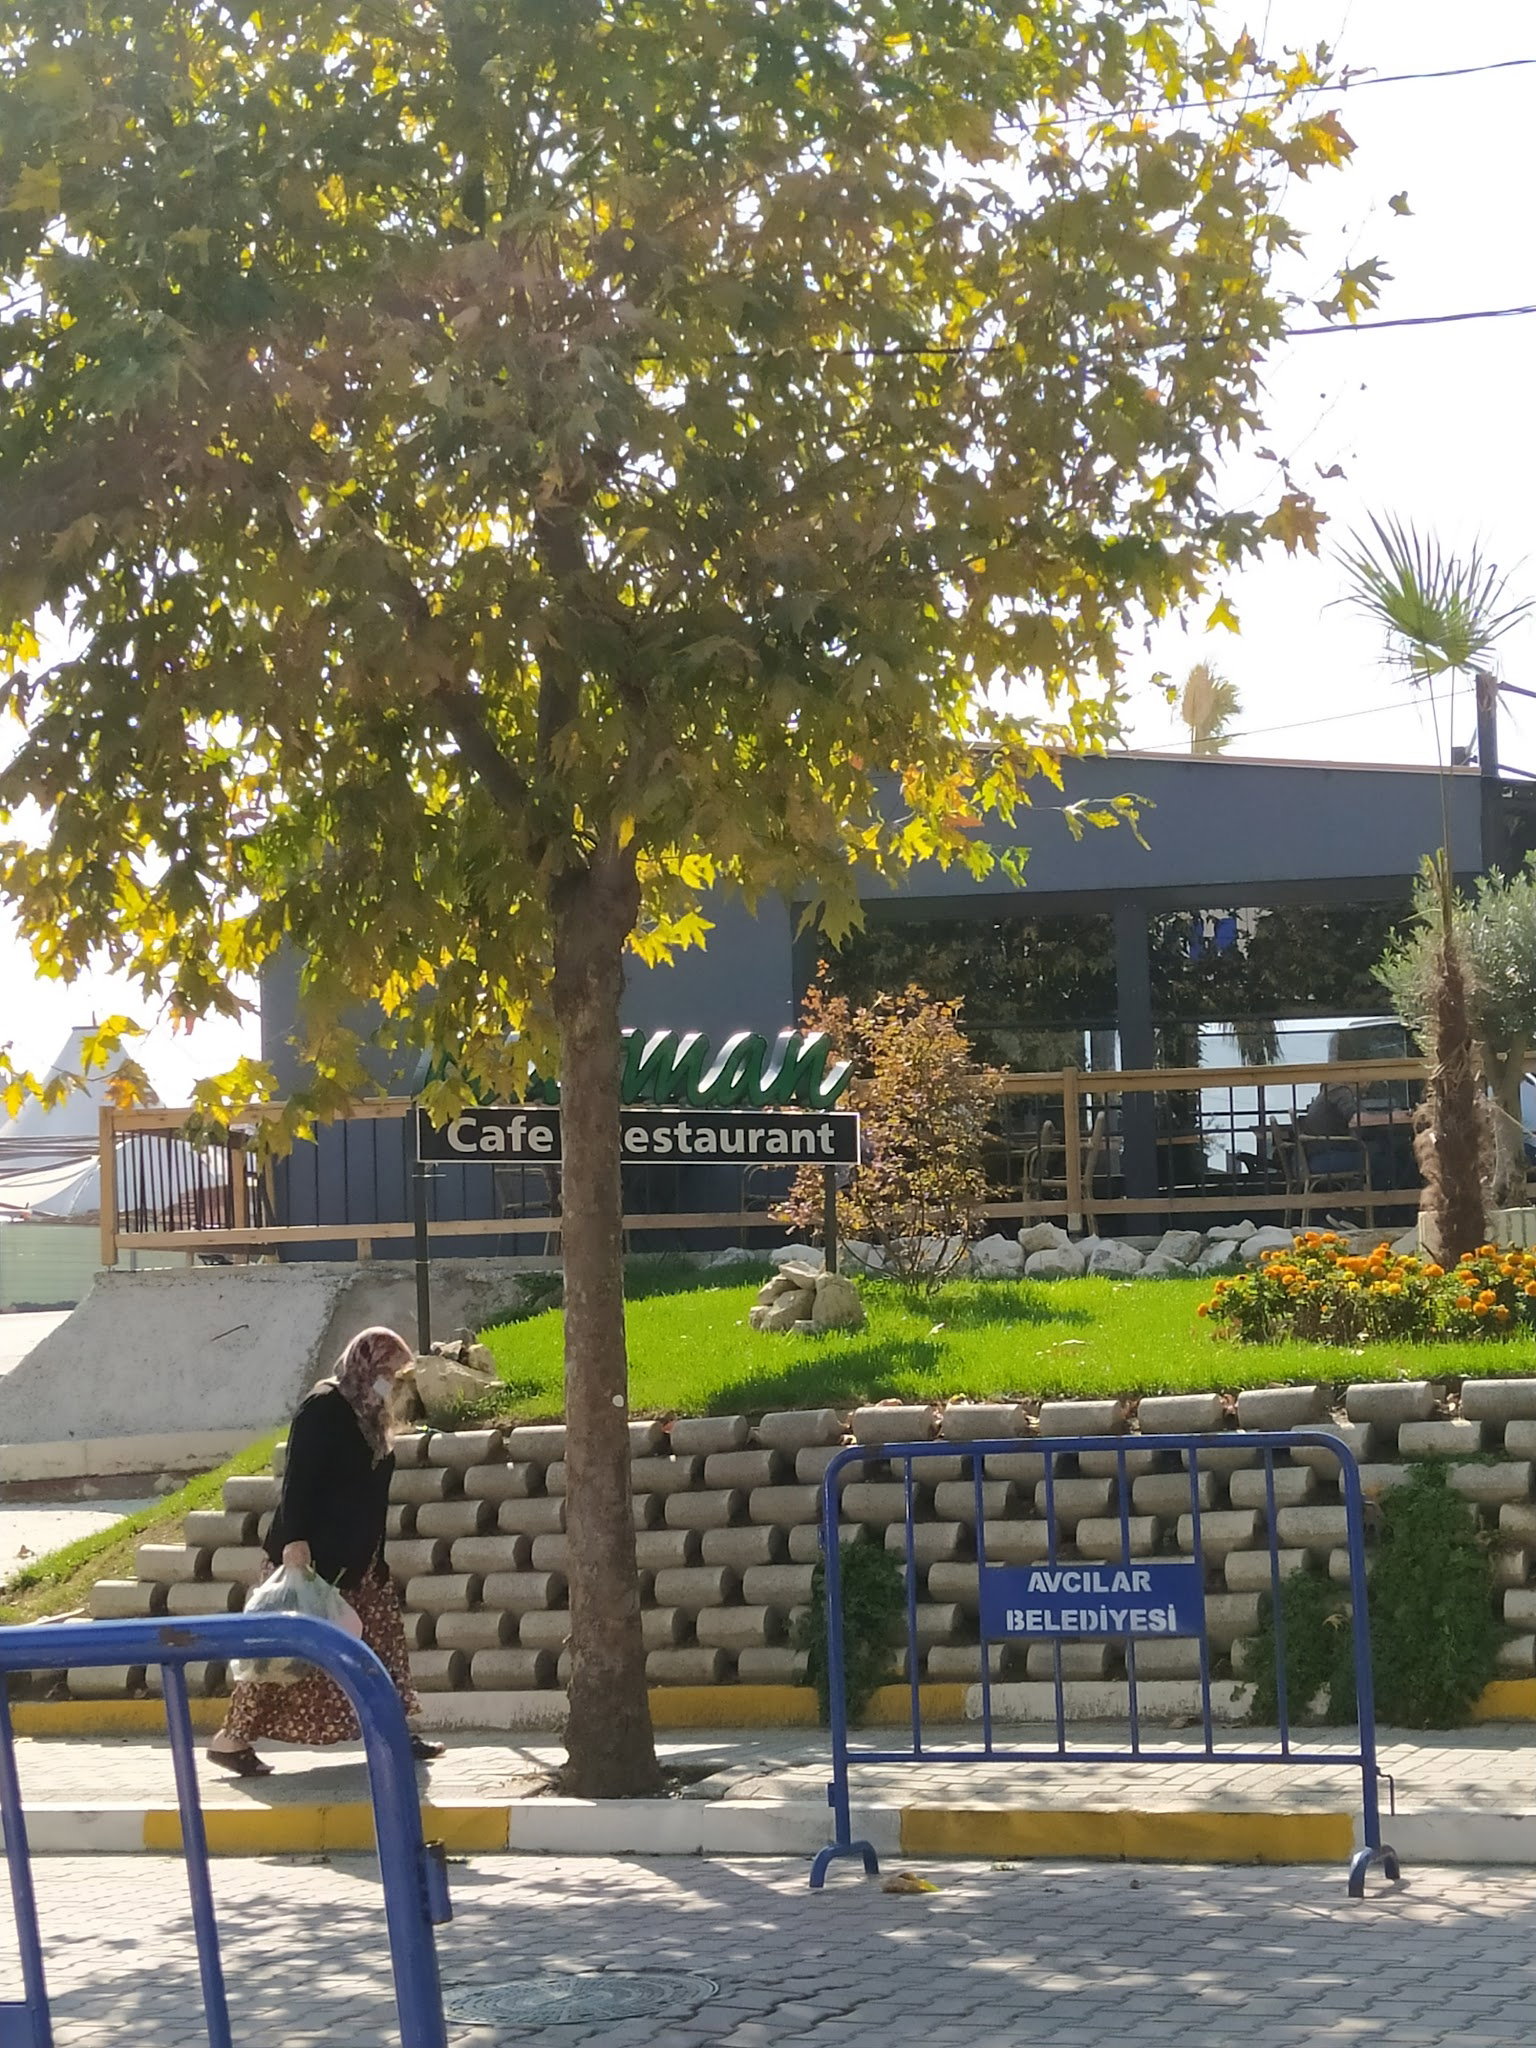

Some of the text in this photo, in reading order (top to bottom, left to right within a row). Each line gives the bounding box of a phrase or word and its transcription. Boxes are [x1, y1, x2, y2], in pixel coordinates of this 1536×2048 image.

[447, 1116, 835, 1154] Cafe estaurant
[1027, 1571, 1152, 1592] AVCILAR
[1007, 1604, 1177, 1631] BELEDİYESİ
